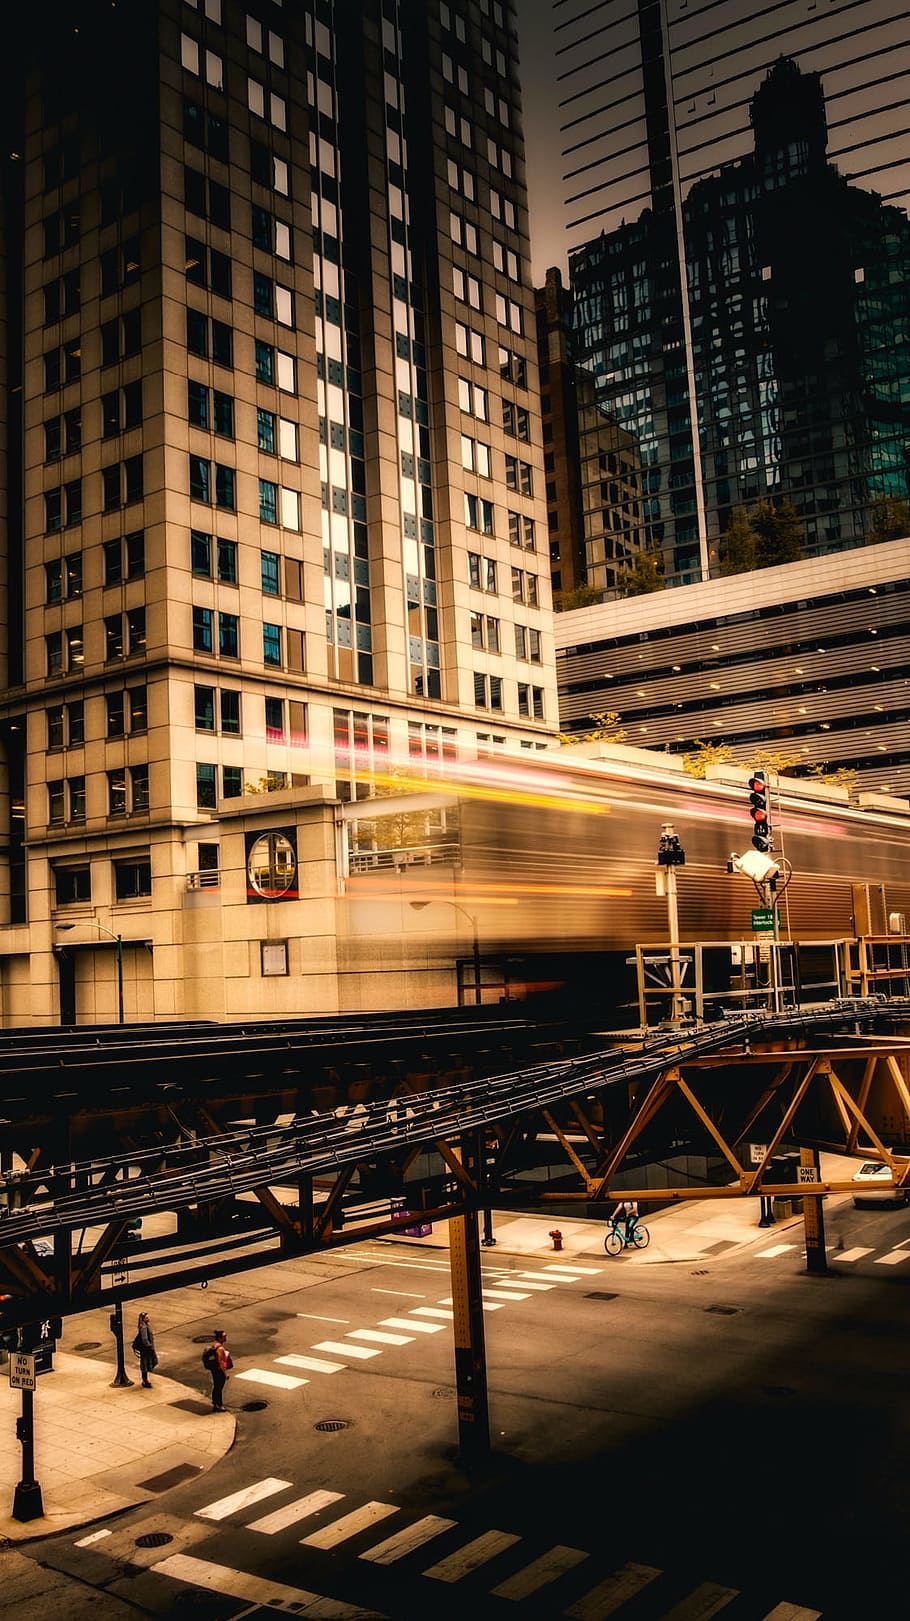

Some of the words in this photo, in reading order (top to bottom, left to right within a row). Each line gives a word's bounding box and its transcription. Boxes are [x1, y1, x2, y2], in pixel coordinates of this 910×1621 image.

[800, 1168, 814, 1176] ONE
[800, 1175, 815, 1183] WAY
[17, 1356, 28, 1366] NO
[15, 1366, 31, 1376] TURN
[11, 1376, 20, 1384] ON
[21, 1377, 34, 1386] RED
